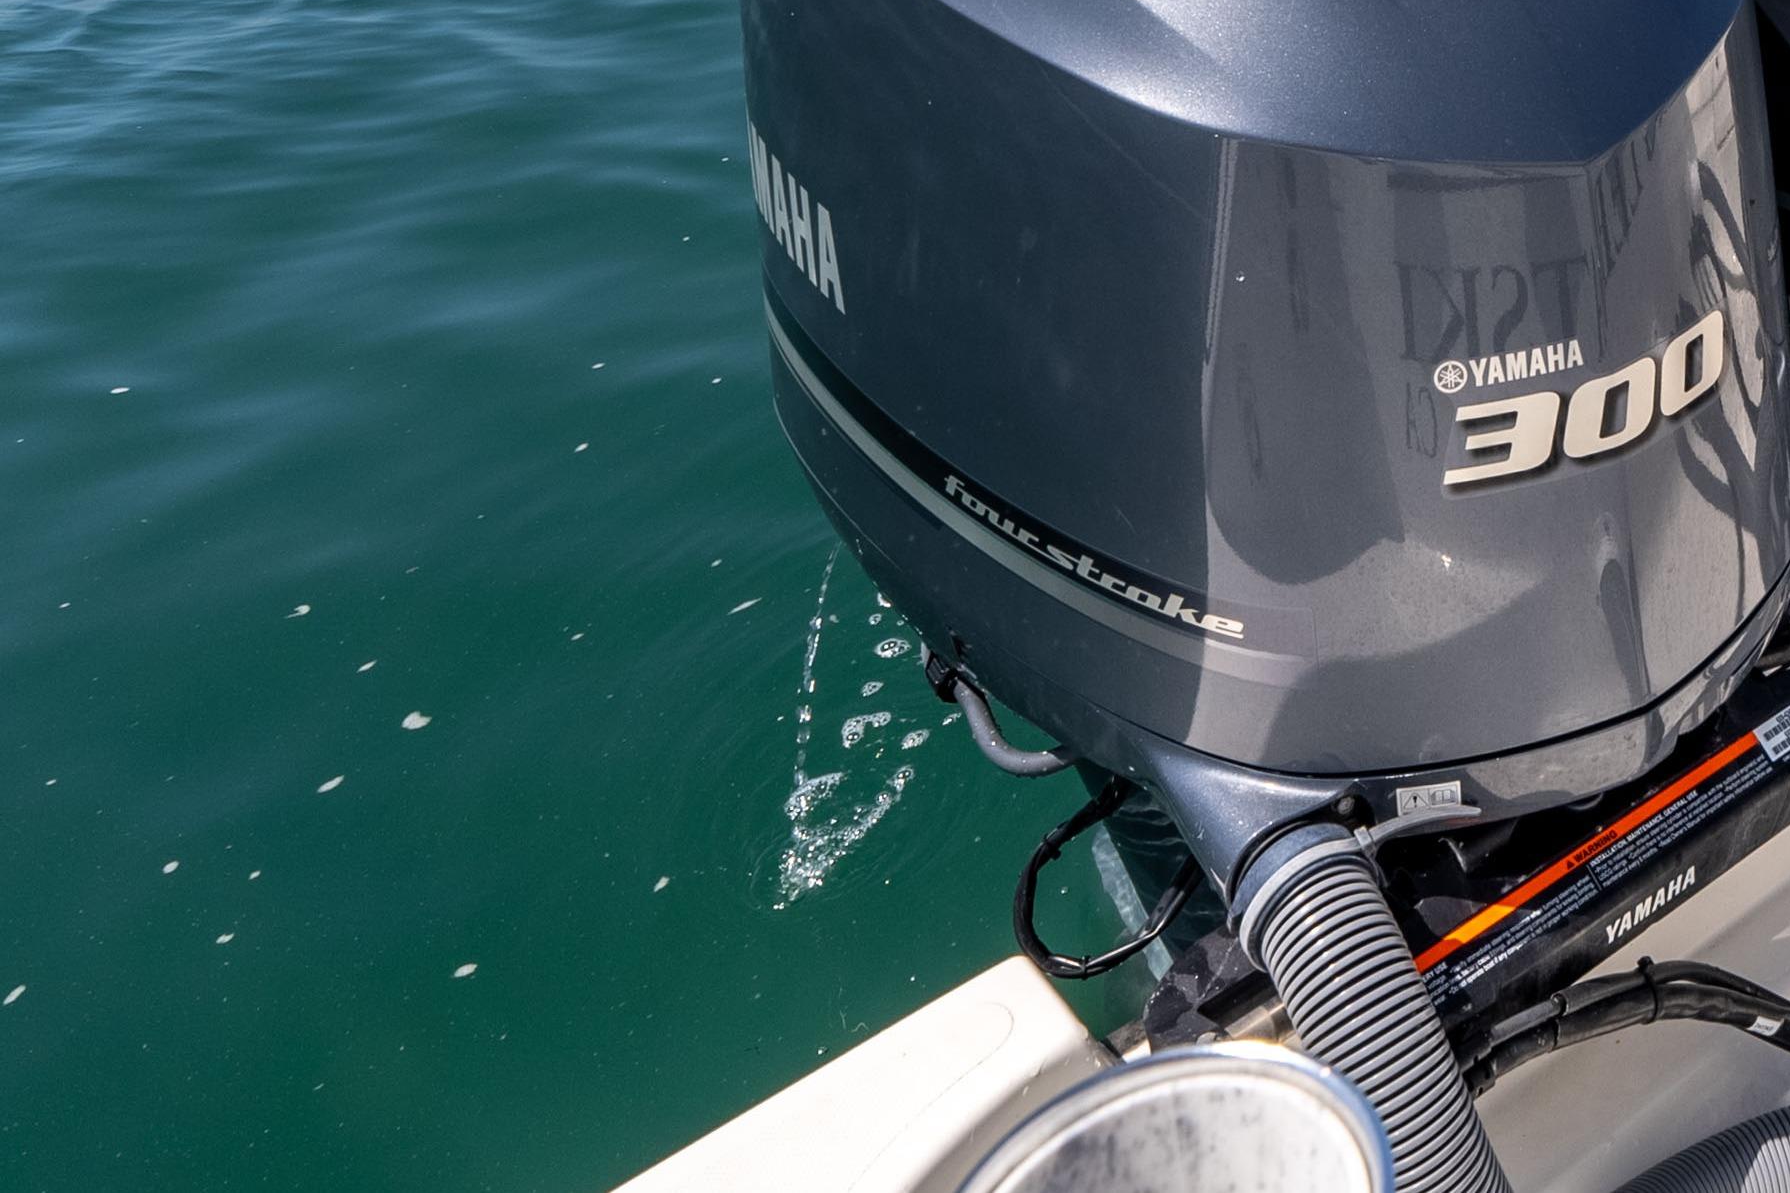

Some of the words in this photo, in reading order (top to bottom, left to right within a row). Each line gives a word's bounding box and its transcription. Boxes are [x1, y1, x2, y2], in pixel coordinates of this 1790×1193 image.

[748, 118, 846, 316] MAHA
[1443, 309, 1724, 485] 300
[1468, 339, 1584, 387] YAMAHA
[1574, 830, 1617, 862] WARNING
[1606, 866, 1696, 944] YAMAHA
